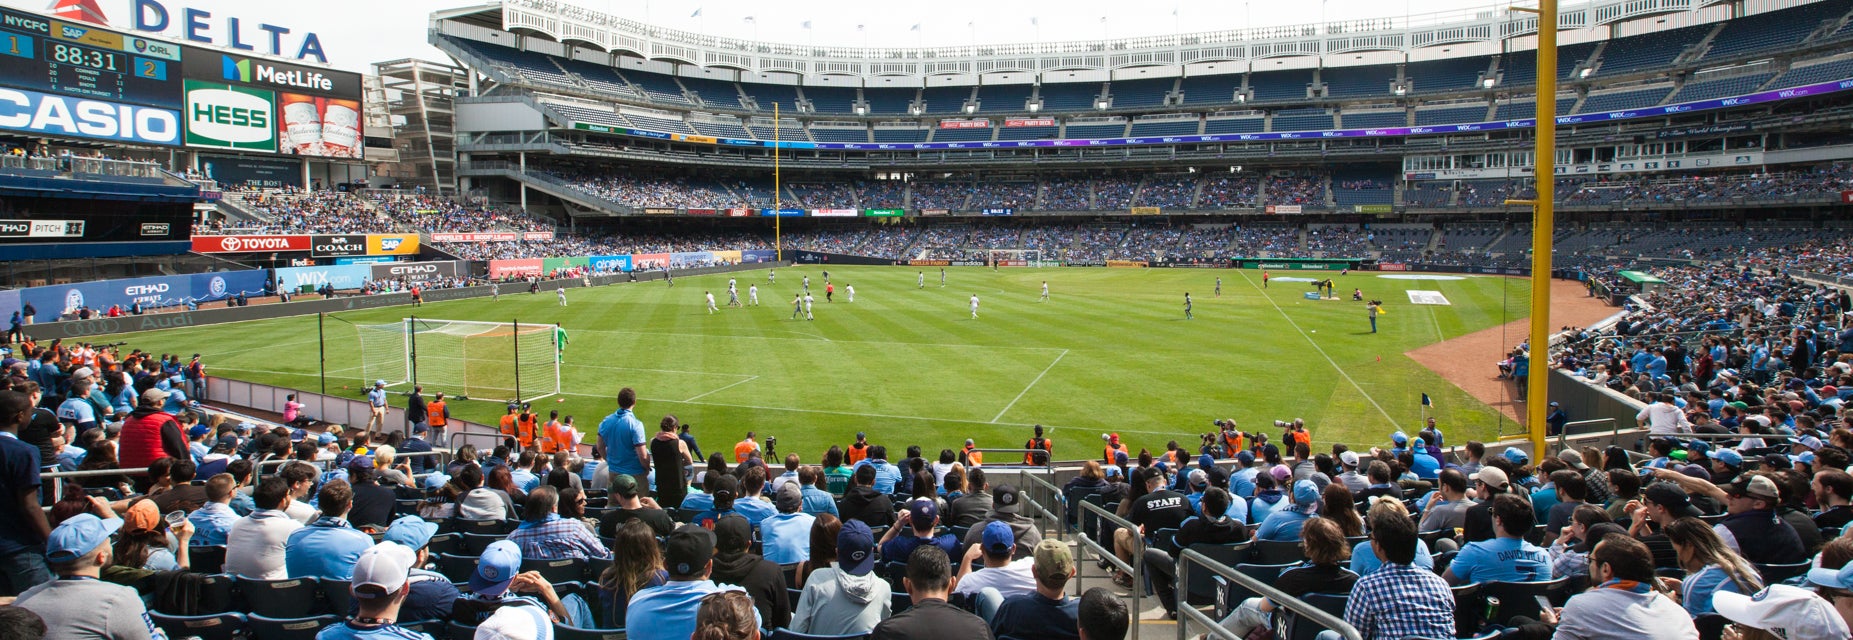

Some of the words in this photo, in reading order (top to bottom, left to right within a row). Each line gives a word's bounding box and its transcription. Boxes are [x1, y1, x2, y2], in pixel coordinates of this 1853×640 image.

[5, 14, 49, 32] NYCFC
[62, 26, 84, 39] SAP
[131, 0, 328, 63] DELTA
[8, 36, 19, 54] 1
[148, 44, 170, 56] ORL
[54, 44, 117, 70] 88:31
[143, 62, 157, 77] 2
[256, 64, 333, 91] MetLife
[0, 88, 177, 142] CASIO
[193, 102, 267, 129] HESS
[246, 179, 262, 187] THE
[36, 224, 61, 232] PITCH
[241, 238, 290, 249] TOYOTA
[316, 244, 362, 252] COACH
[381, 239, 400, 250] SAP
[292, 259, 315, 267] FedEx
[390, 264, 437, 275] ETIHAD
[125, 283, 170, 296] ETIHAD
[140, 313, 194, 330] Audi
[825, 475, 848, 483] Corona
[1147, 497, 1182, 509] STAFF
[1497, 549, 1523, 562] DAVID
[1525, 550, 1547, 565] VILLA
